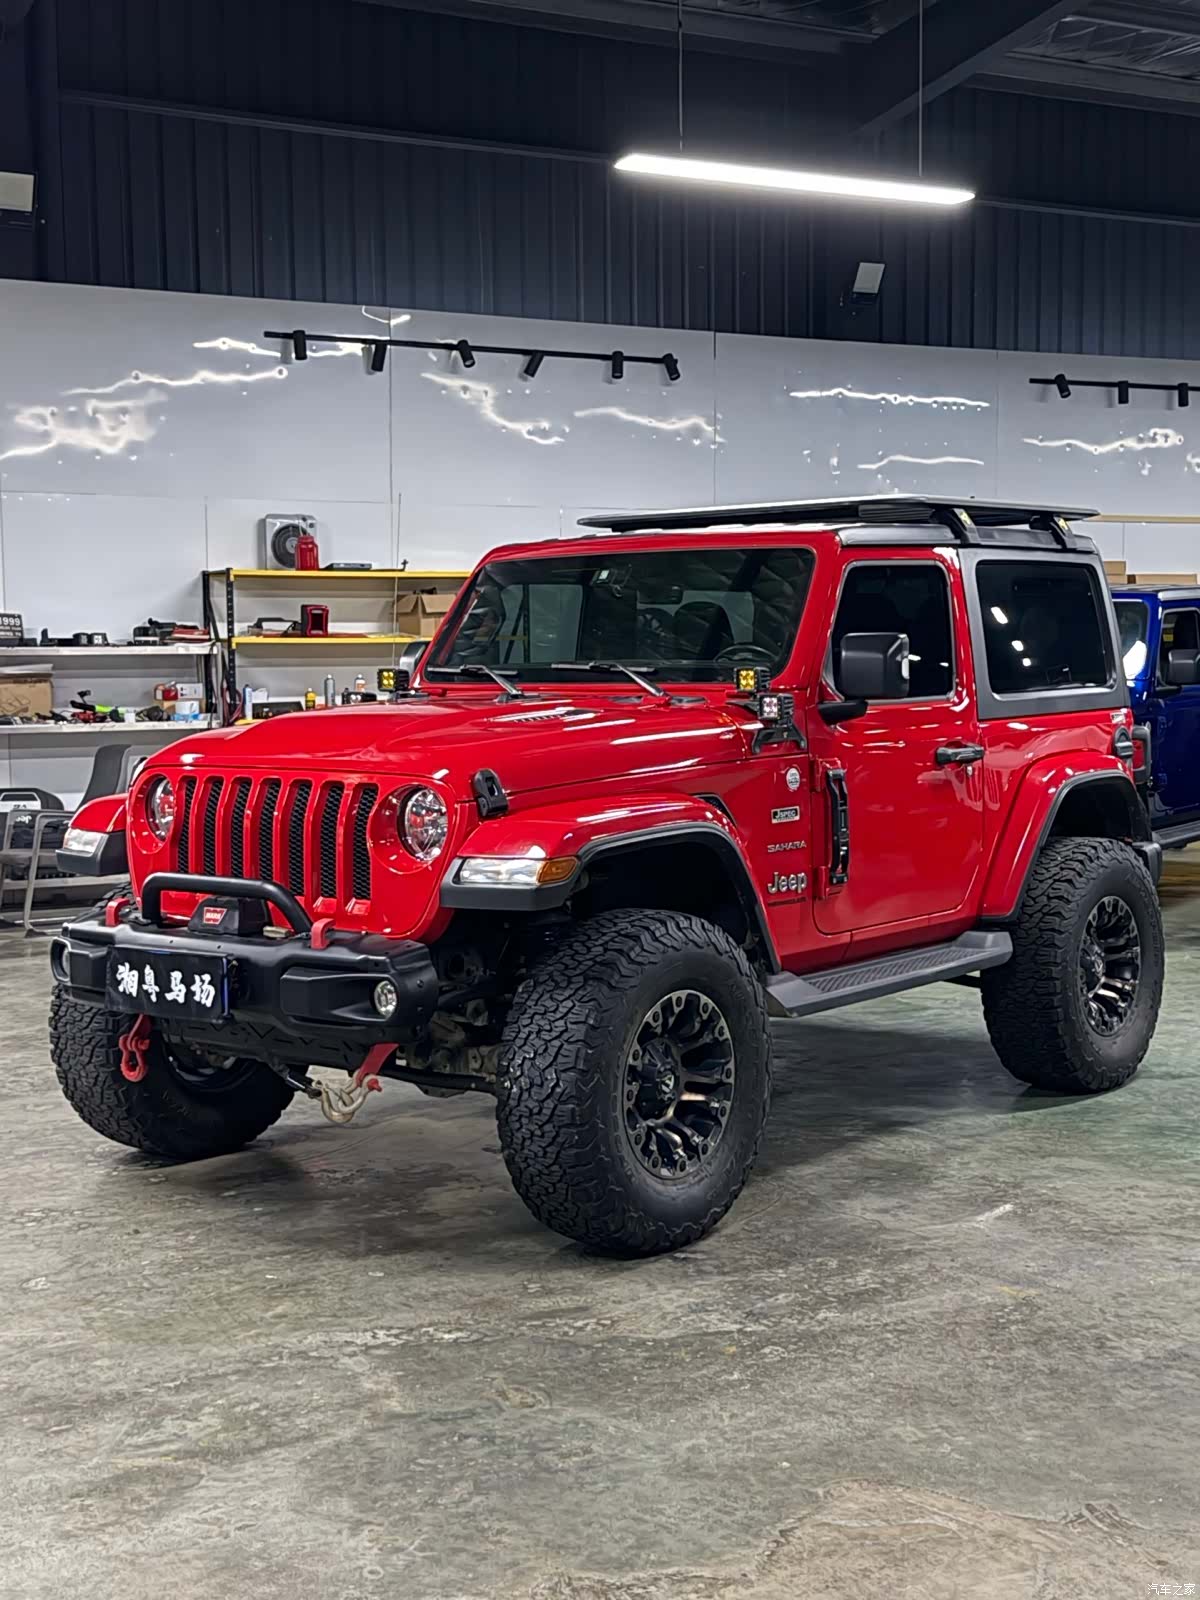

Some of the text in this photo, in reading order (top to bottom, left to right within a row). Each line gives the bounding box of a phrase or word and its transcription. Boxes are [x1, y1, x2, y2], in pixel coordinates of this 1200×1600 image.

[767, 840, 807, 853] SAHARA
[767, 871, 807, 894] Jeep
[116, 962, 215, 1007] 湘粤马场
